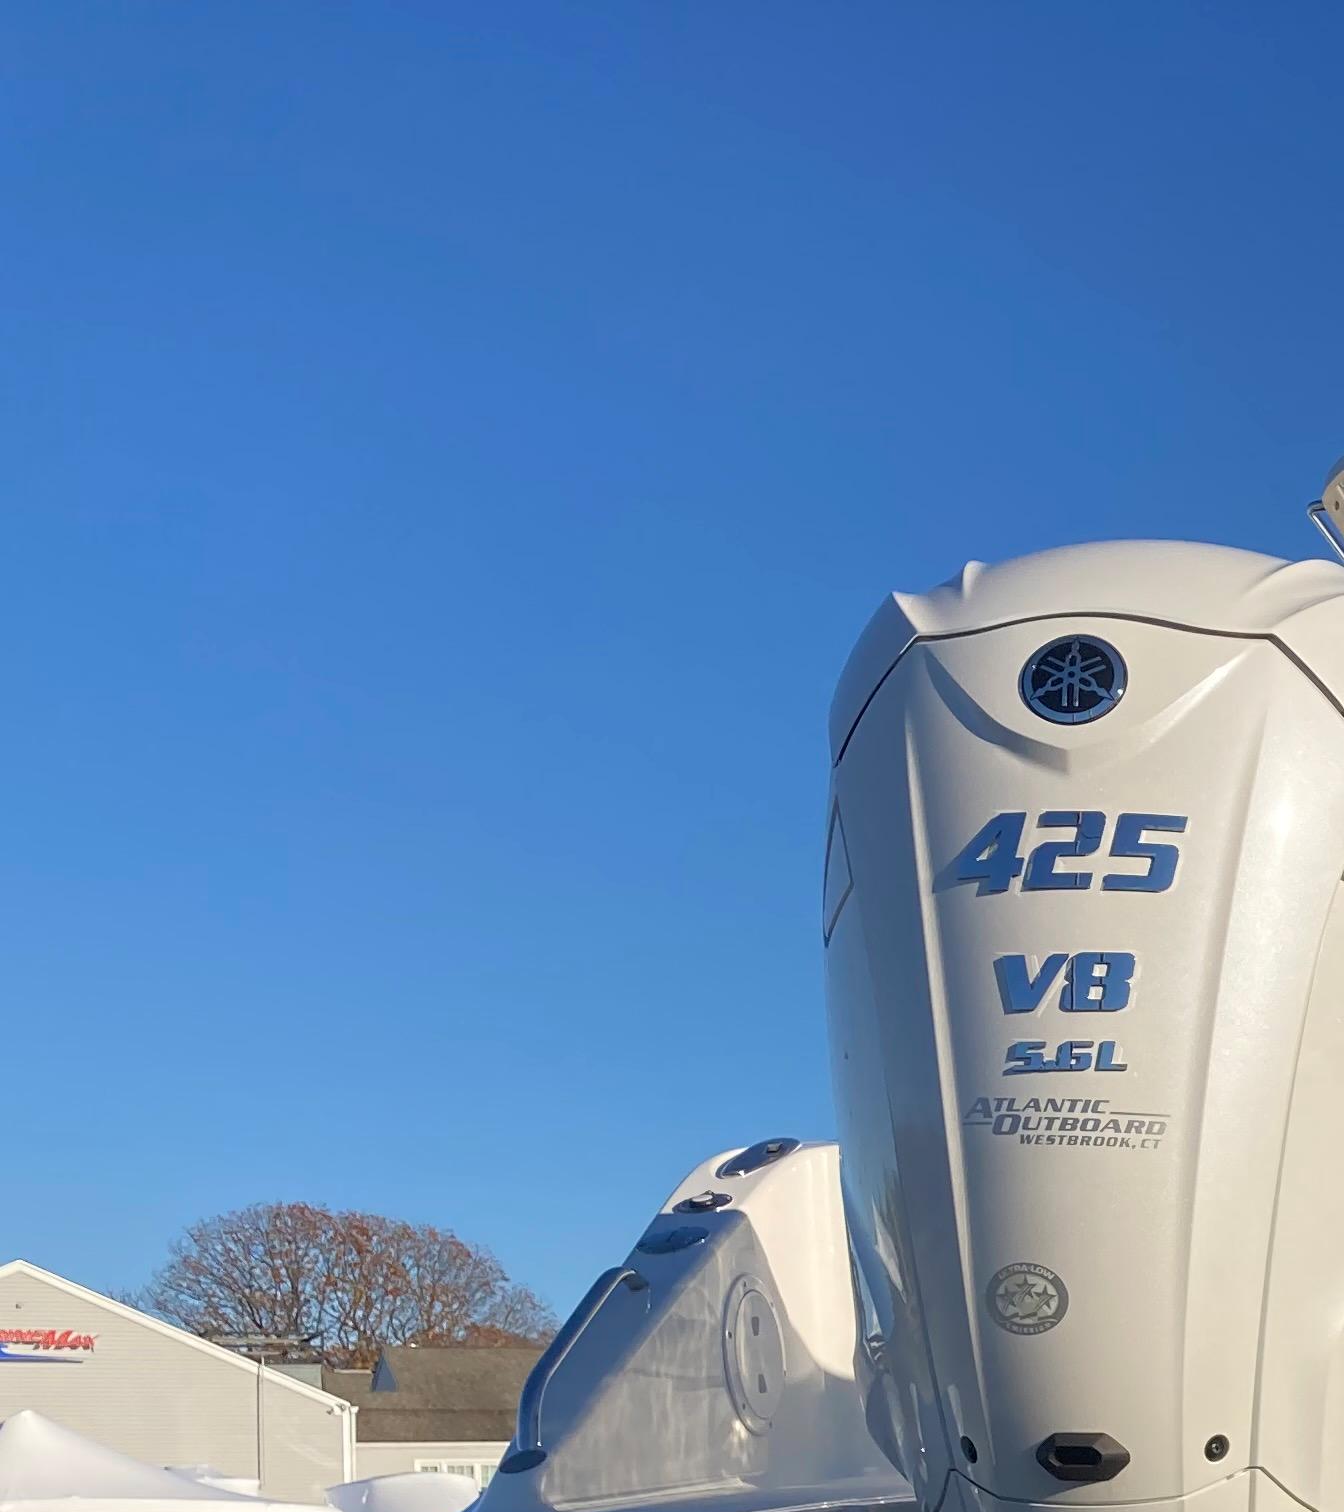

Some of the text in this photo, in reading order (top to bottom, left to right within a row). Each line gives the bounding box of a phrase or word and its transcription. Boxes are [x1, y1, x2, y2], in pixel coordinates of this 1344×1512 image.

[938, 810, 1189, 896] 425
[993, 951, 1137, 1015] V8
[1003, 1040, 1128, 1076] 5.6L
[964, 1097, 1110, 1119] ATLANTIC
[992, 1114, 1168, 1136] OUTBOARD
[1019, 1134, 1161, 1150] WESTBROOK, CT
